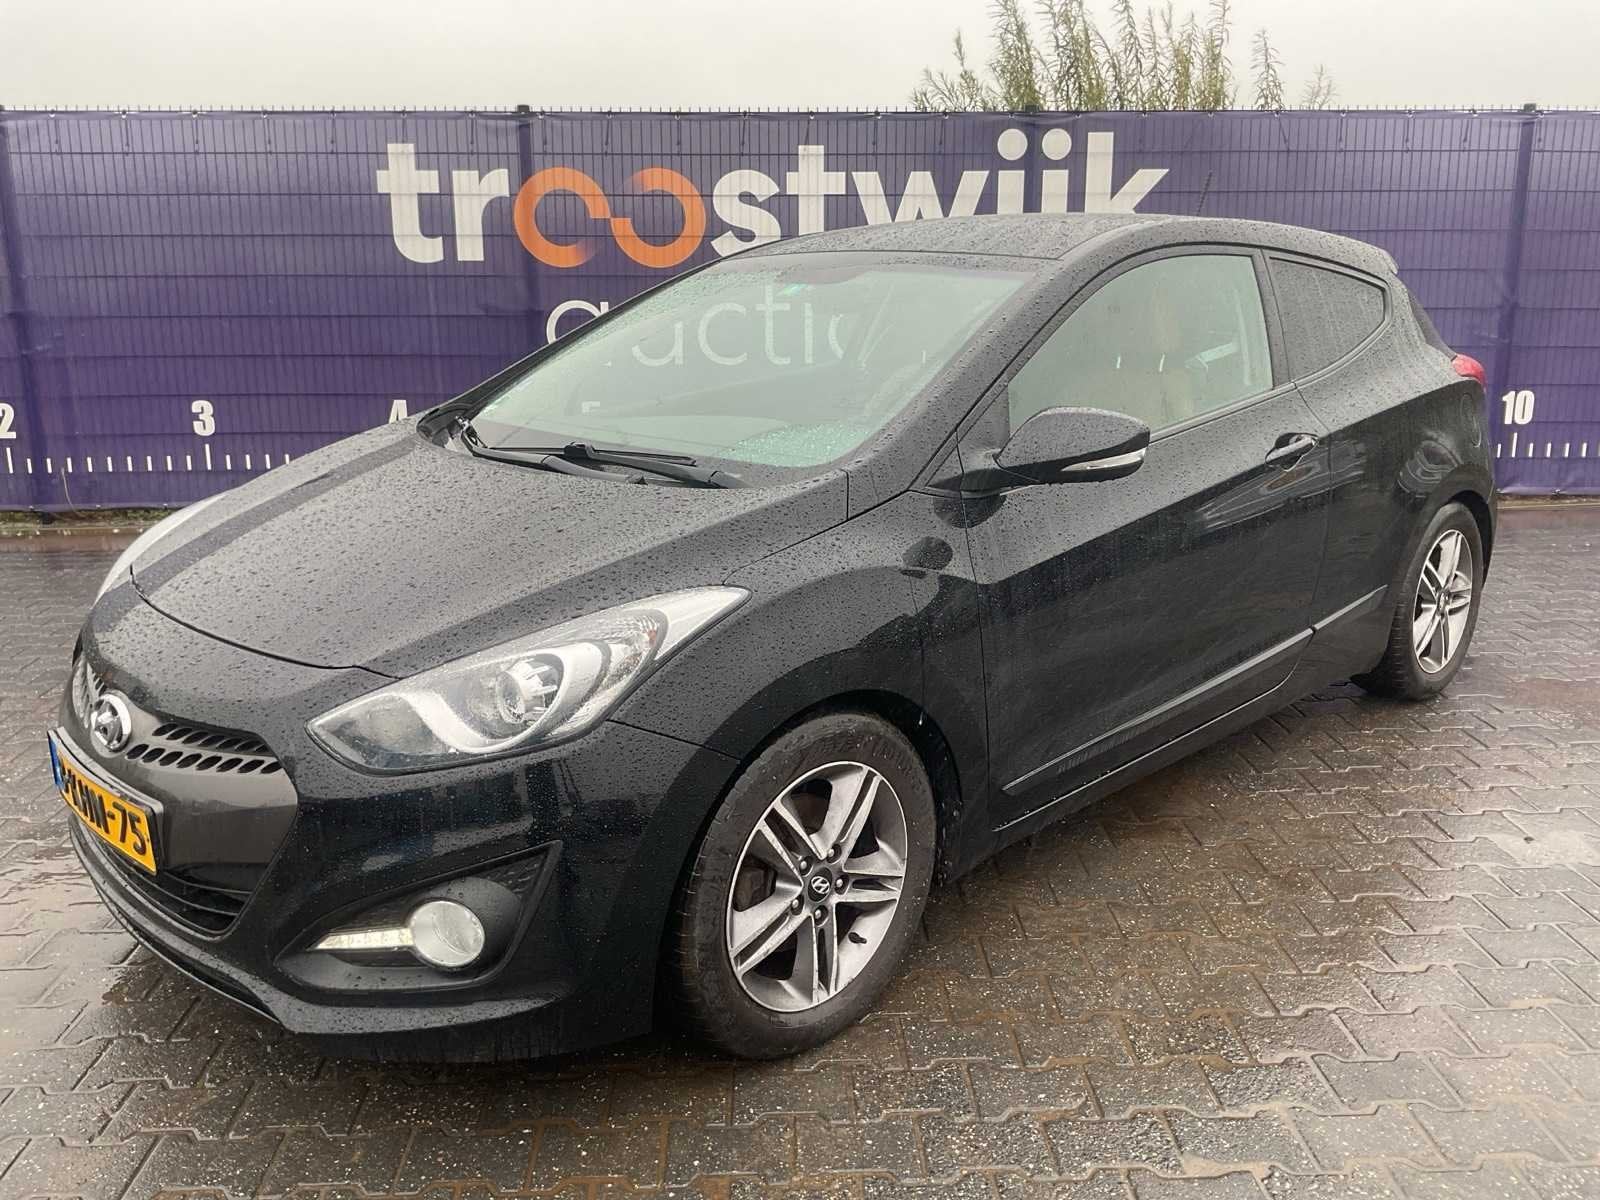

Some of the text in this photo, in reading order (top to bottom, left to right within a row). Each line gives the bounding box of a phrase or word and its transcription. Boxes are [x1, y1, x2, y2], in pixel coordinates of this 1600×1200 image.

[0, 402, 17, 439] 2
[192, 400, 216, 437] 3
[1502, 390, 1535, 424] 10
